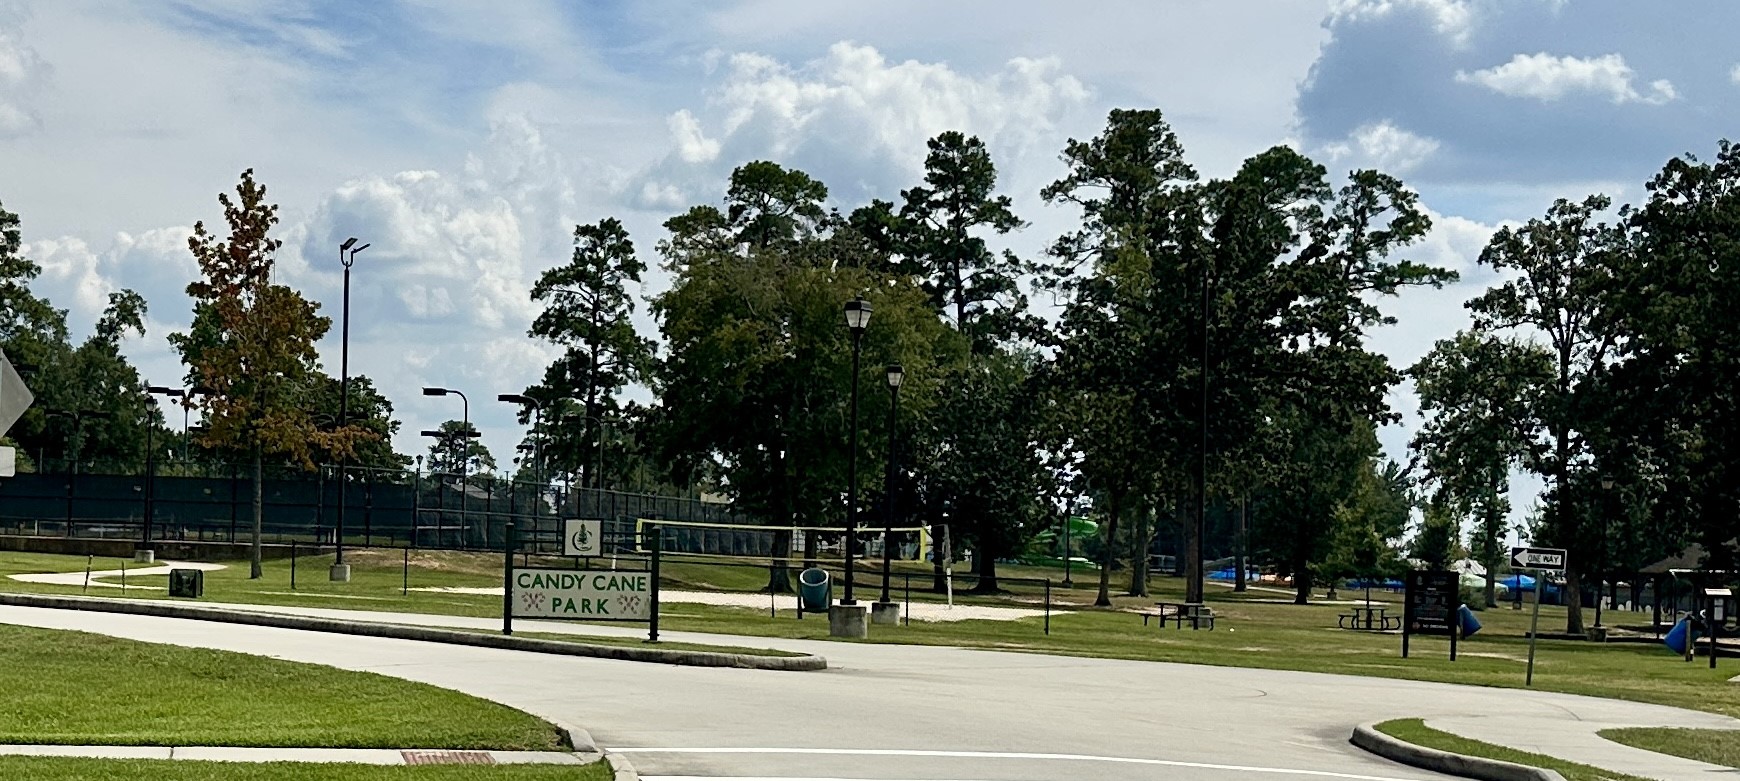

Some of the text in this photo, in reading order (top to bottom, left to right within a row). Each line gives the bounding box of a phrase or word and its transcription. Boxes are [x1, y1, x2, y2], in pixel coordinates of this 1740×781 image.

[1528, 554, 1559, 563] ONE WAY
[517, 573, 647, 592] CANDY CANE
[552, 597, 610, 615] PARK
